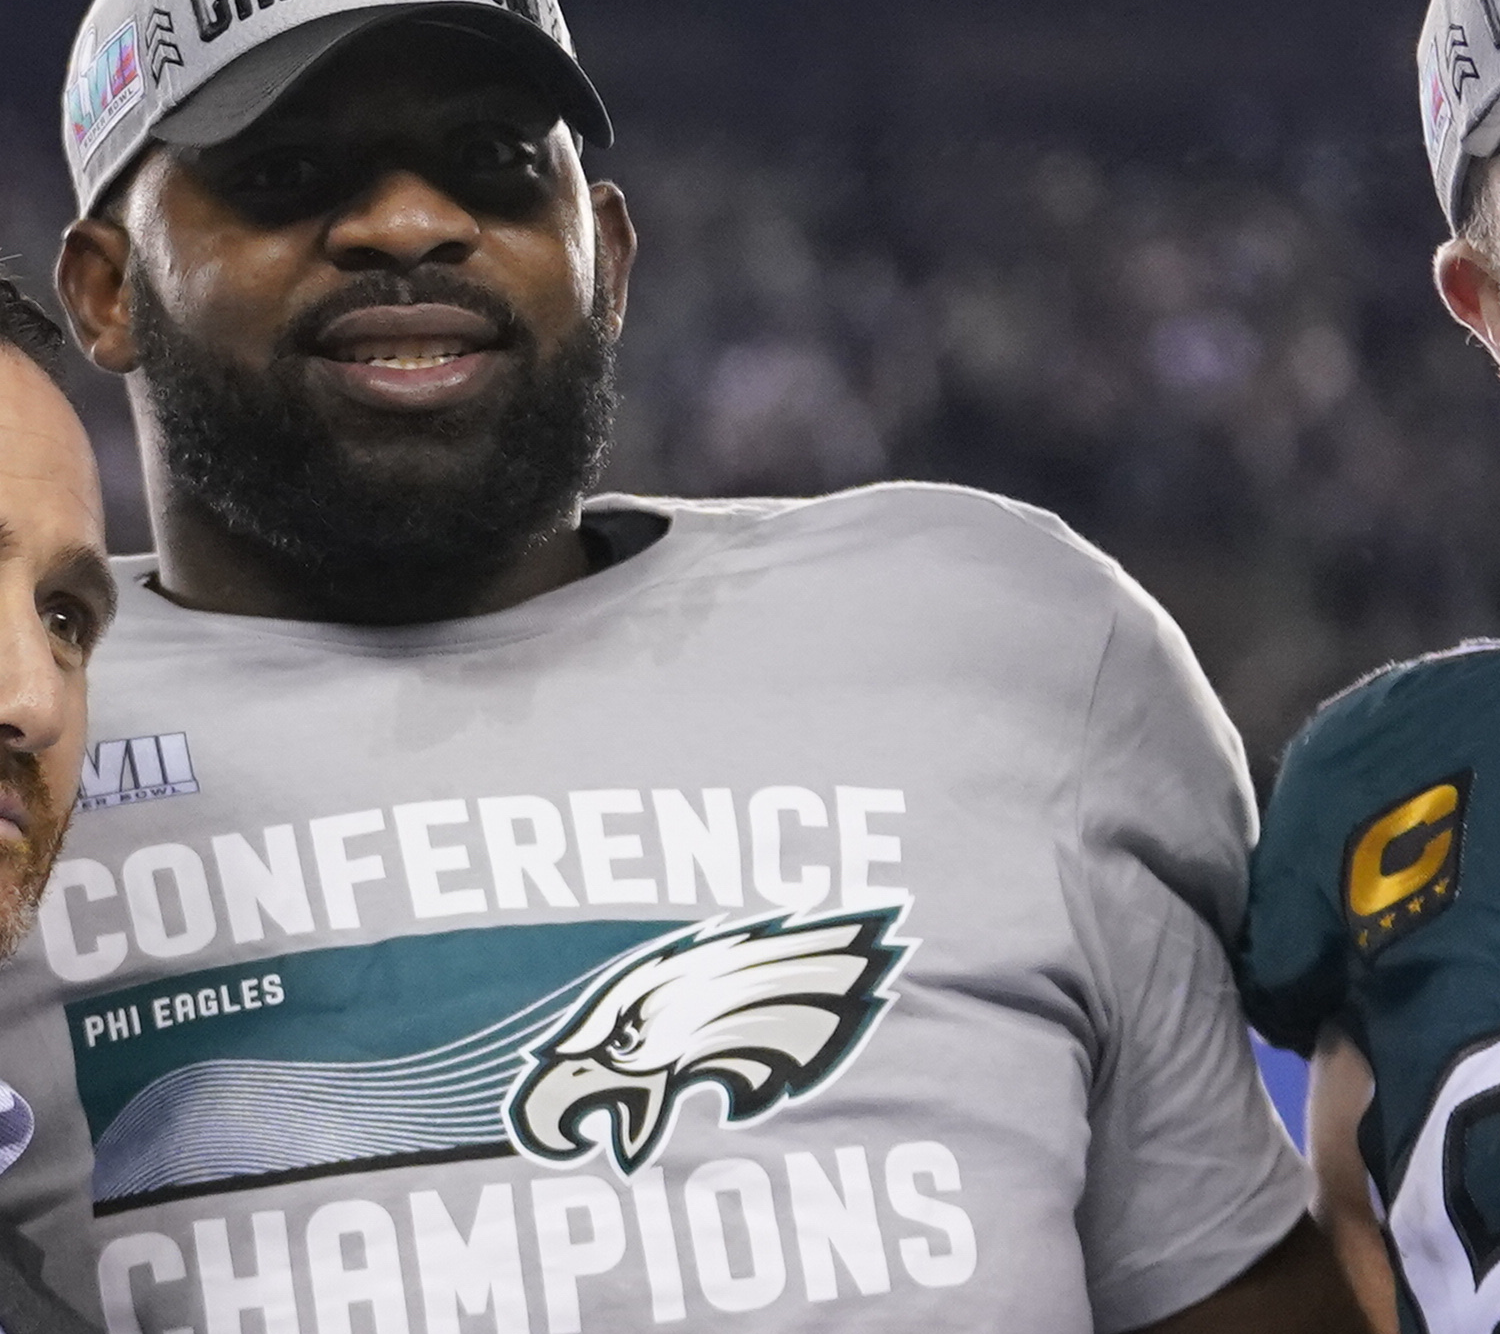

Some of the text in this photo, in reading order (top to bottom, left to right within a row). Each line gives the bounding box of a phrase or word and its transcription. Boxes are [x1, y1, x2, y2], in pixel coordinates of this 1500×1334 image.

[83, 88, 133, 149] SUPER BOWL
[38, 785, 906, 984] CONFERENCE
[84, 973, 286, 1048] PHI EAGLES
